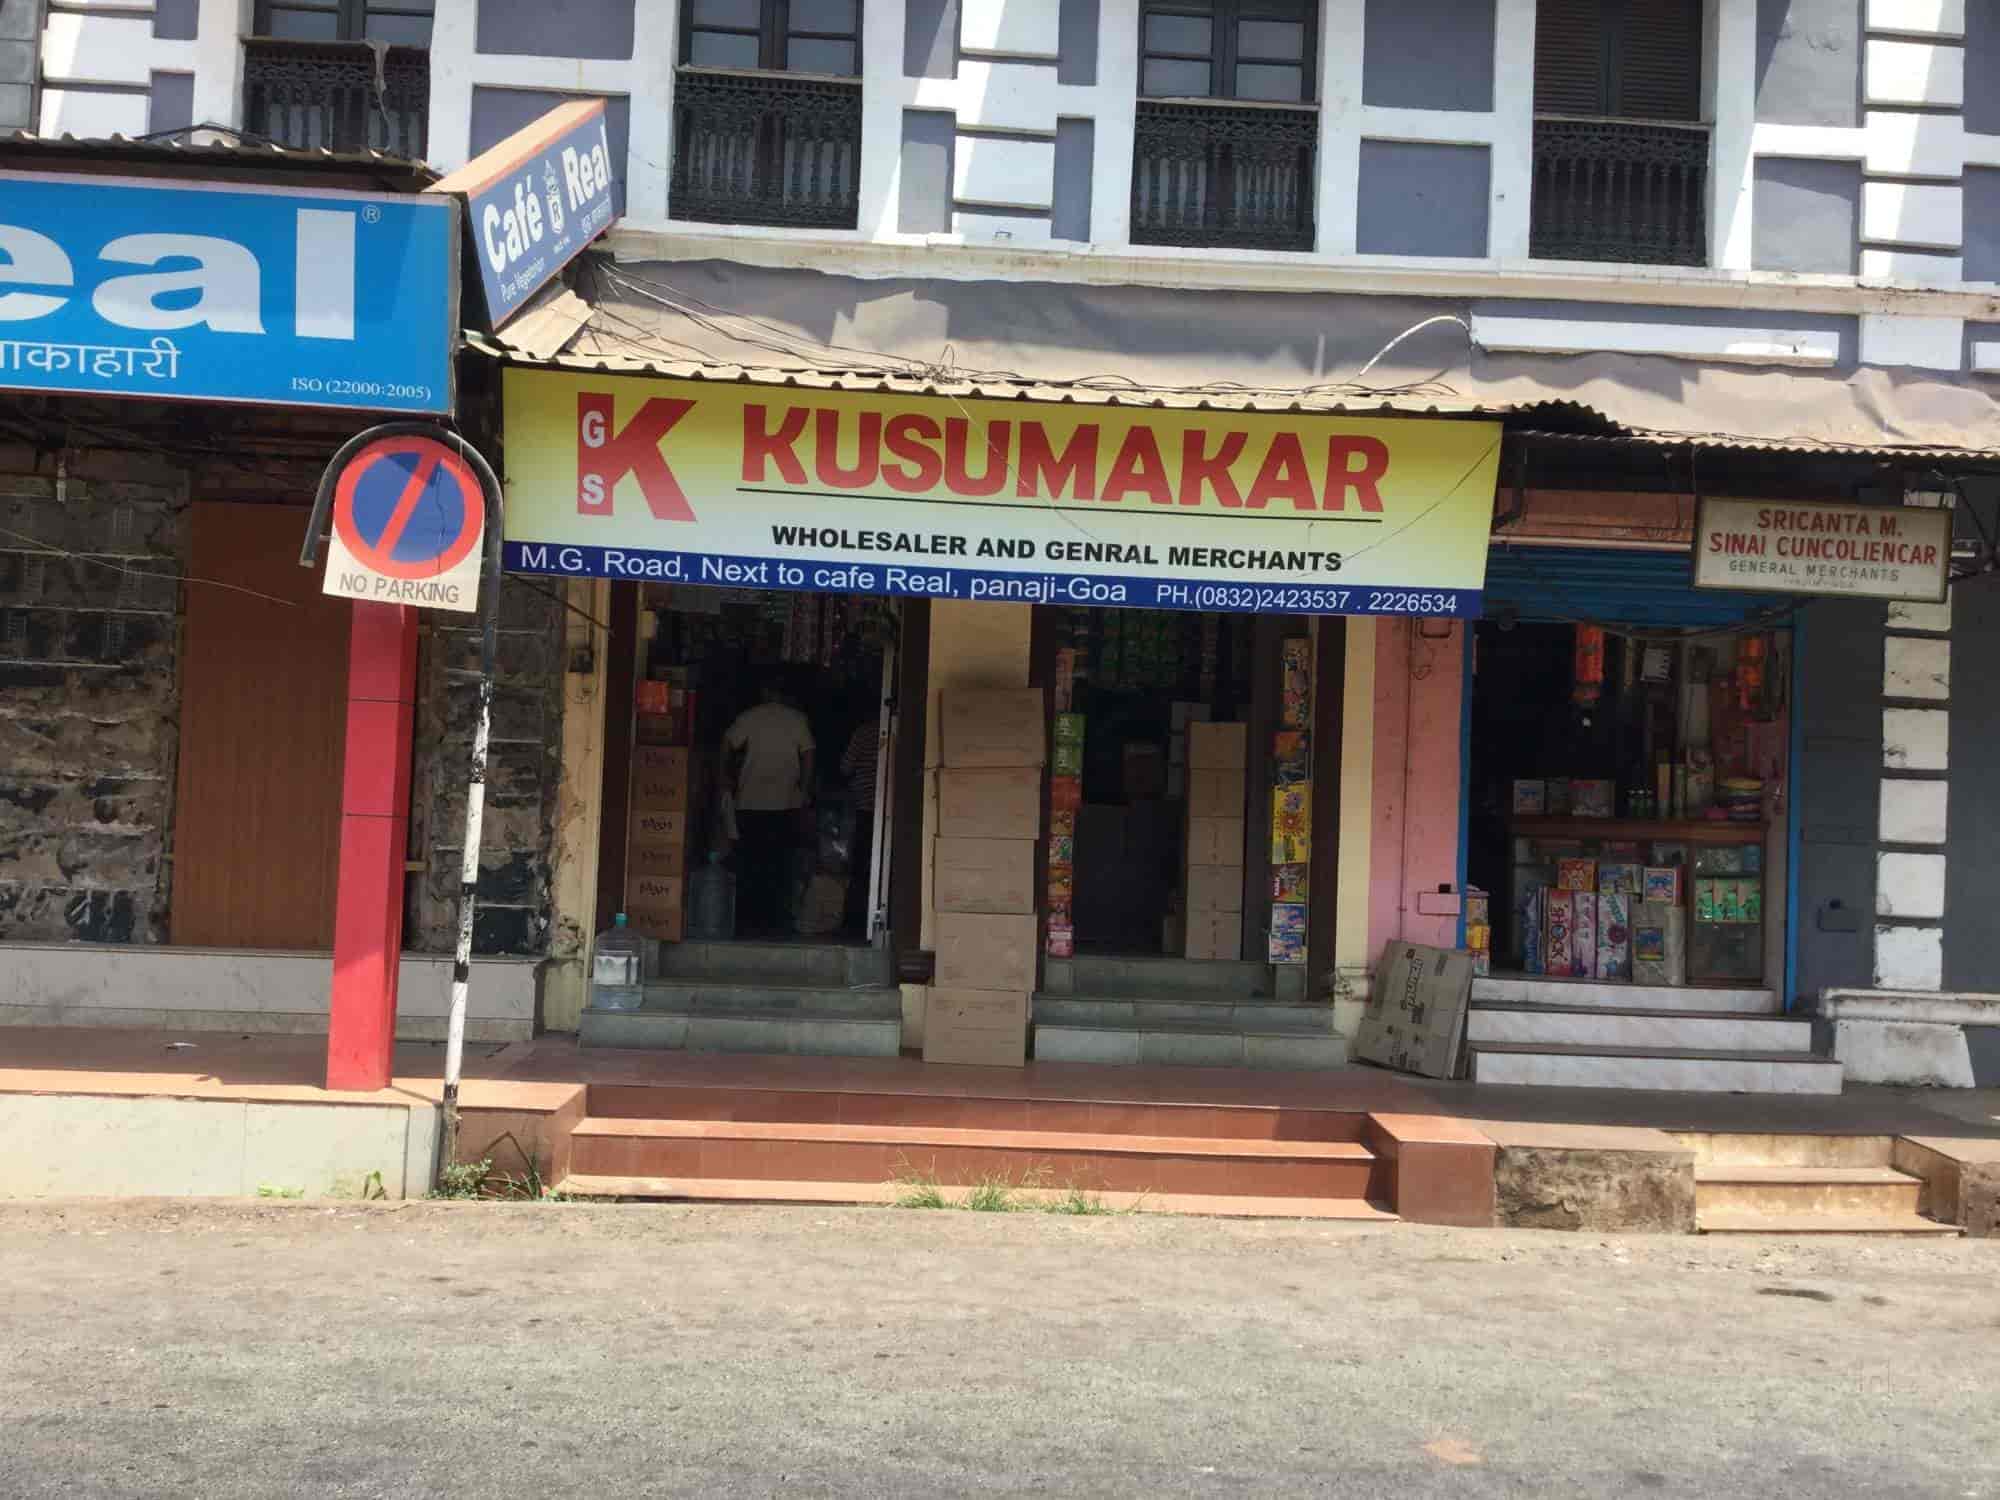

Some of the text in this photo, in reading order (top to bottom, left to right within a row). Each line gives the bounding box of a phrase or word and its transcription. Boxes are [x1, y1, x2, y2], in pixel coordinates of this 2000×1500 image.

[483, 175, 543, 273] Café
[561, 124, 610, 212] Real
[0, 337, 182, 379] ाकाहारी
[292, 377, 432, 401] ISO (22000:2005)
[582, 411, 605, 449] G
[741, 402, 1390, 514] KUSUMAKAR
[582, 473, 605, 505] S
[1757, 508, 1903, 537] SRICANTA M.
[772, 525, 1343, 572] WHOLESALER AND GENRAL MERCHANTS
[1708, 532, 1937, 565] SINAI CUNCOLIENCAR
[339, 572, 459, 604] NO PARKING
[520, 545, 592, 572] M.G.
[603, 550, 689, 582] Road,
[701, 557, 768, 583] Next
[778, 563, 804, 585] to
[814, 566, 875, 589] cafe
[885, 568, 959, 598] Real,
[970, 576, 1127, 604] panaji-Goa
[1368, 592, 1457, 613] 2226534
[1729, 559, 1900, 582] GENERAL MERCHANTS
